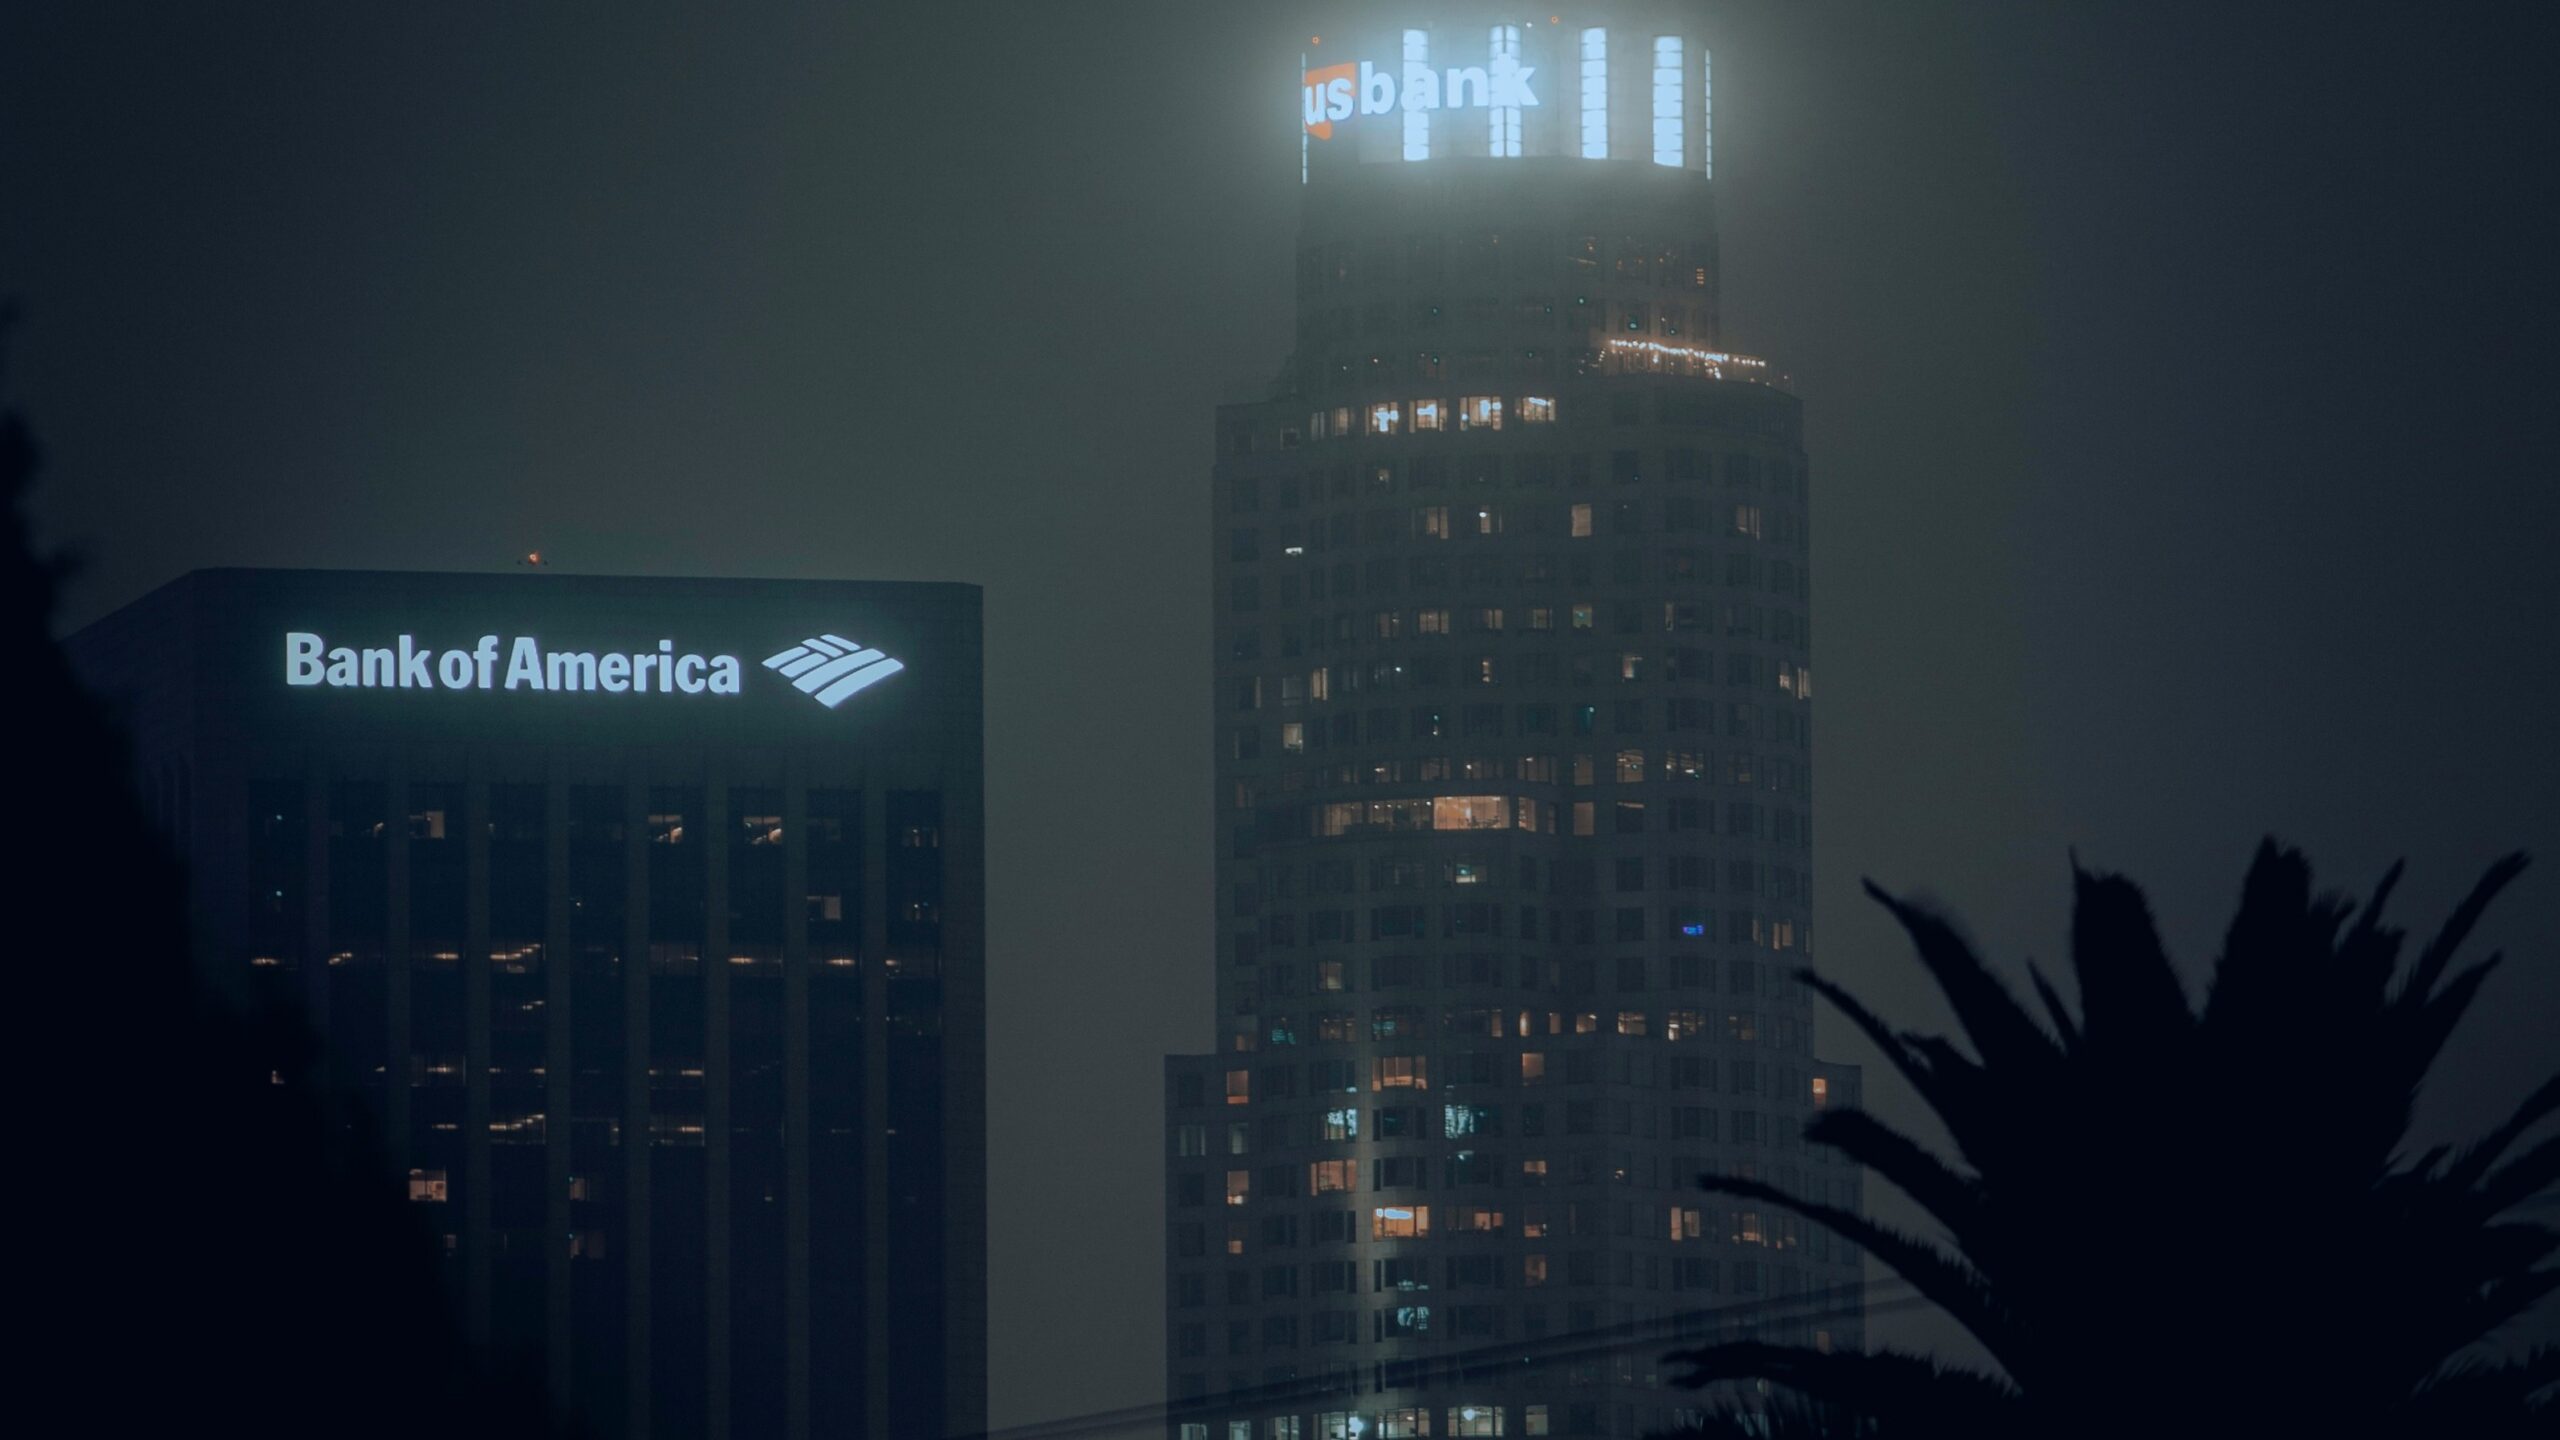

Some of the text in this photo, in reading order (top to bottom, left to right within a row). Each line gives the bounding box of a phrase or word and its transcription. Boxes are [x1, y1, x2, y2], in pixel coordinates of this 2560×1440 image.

[286, 632, 741, 695] Bank of America
